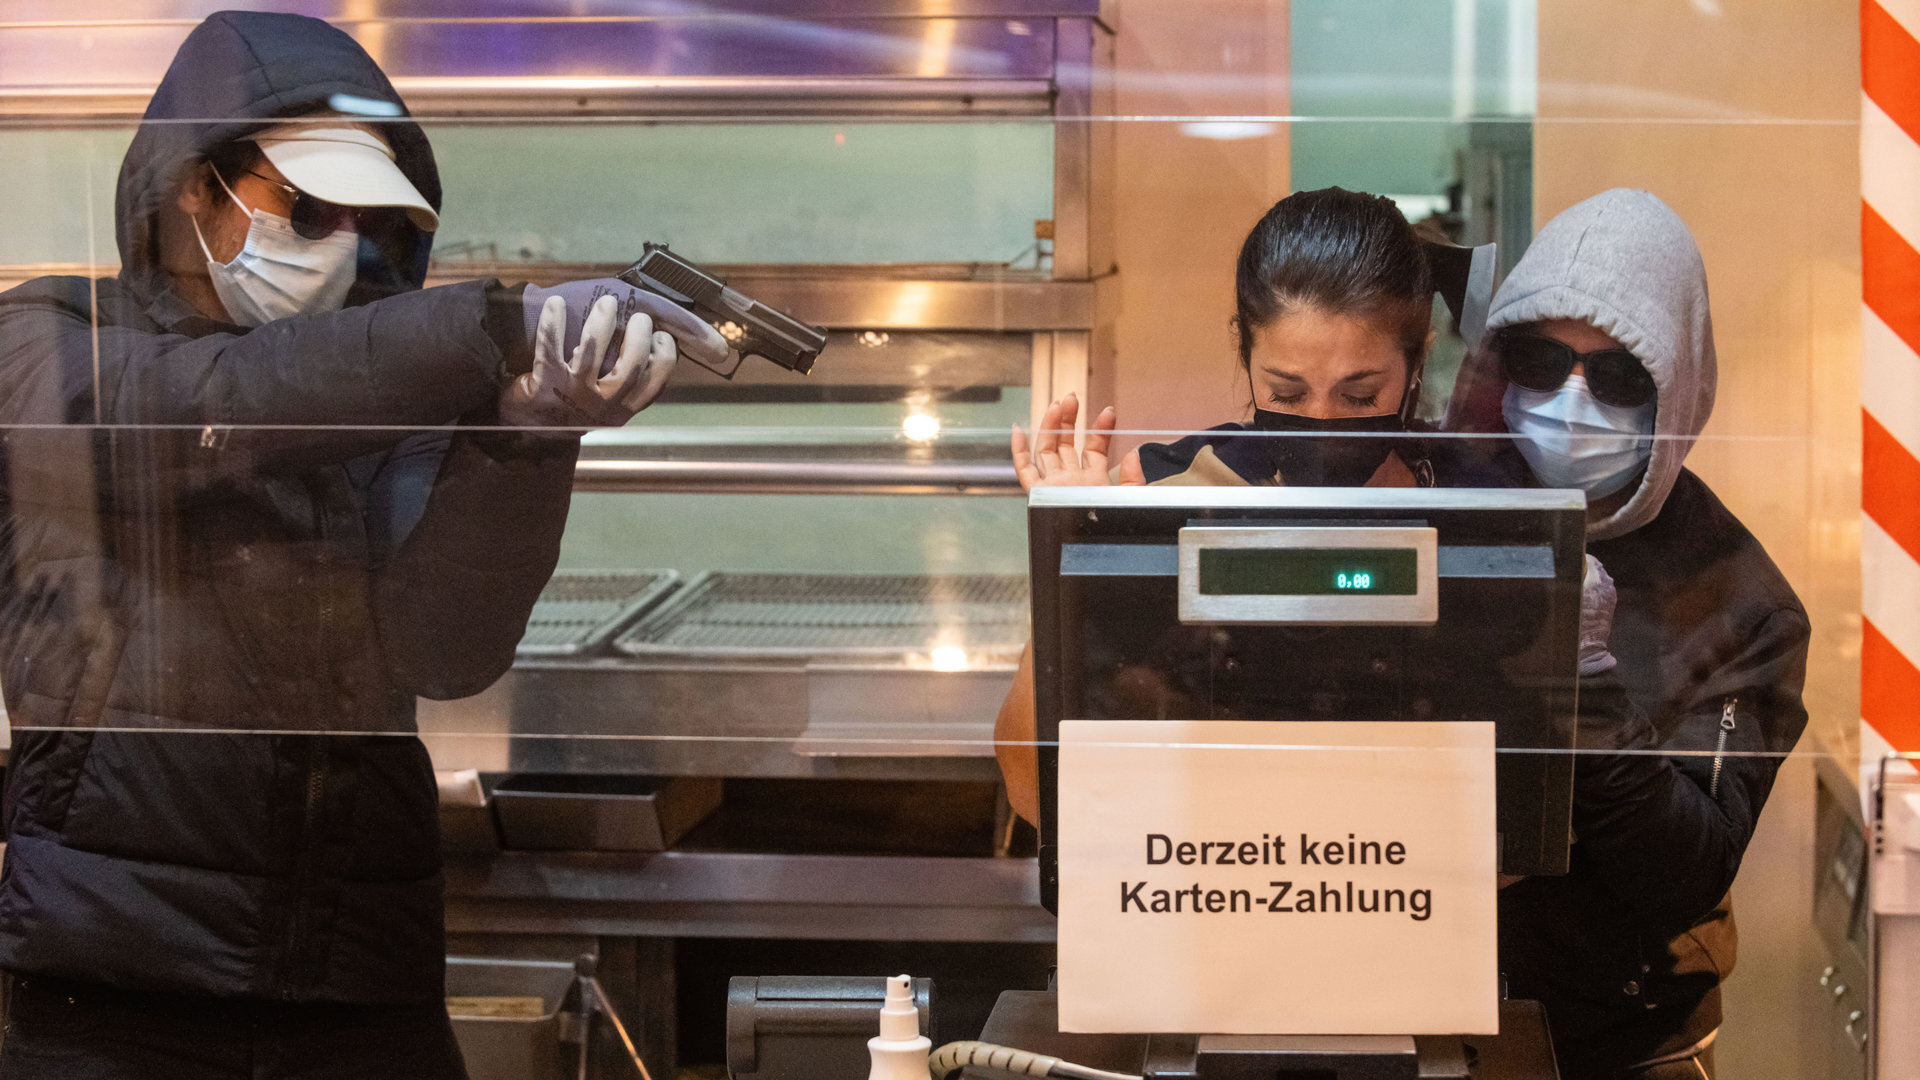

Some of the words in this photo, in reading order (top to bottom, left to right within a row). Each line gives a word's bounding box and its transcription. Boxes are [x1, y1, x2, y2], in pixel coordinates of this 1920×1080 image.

[1337, 573, 1370, 589] 0,00
[1146, 833, 1287, 866] Derzeit
[1300, 833, 1407, 866] keine
[1120, 880, 1432, 922] Karten-Zahlung
